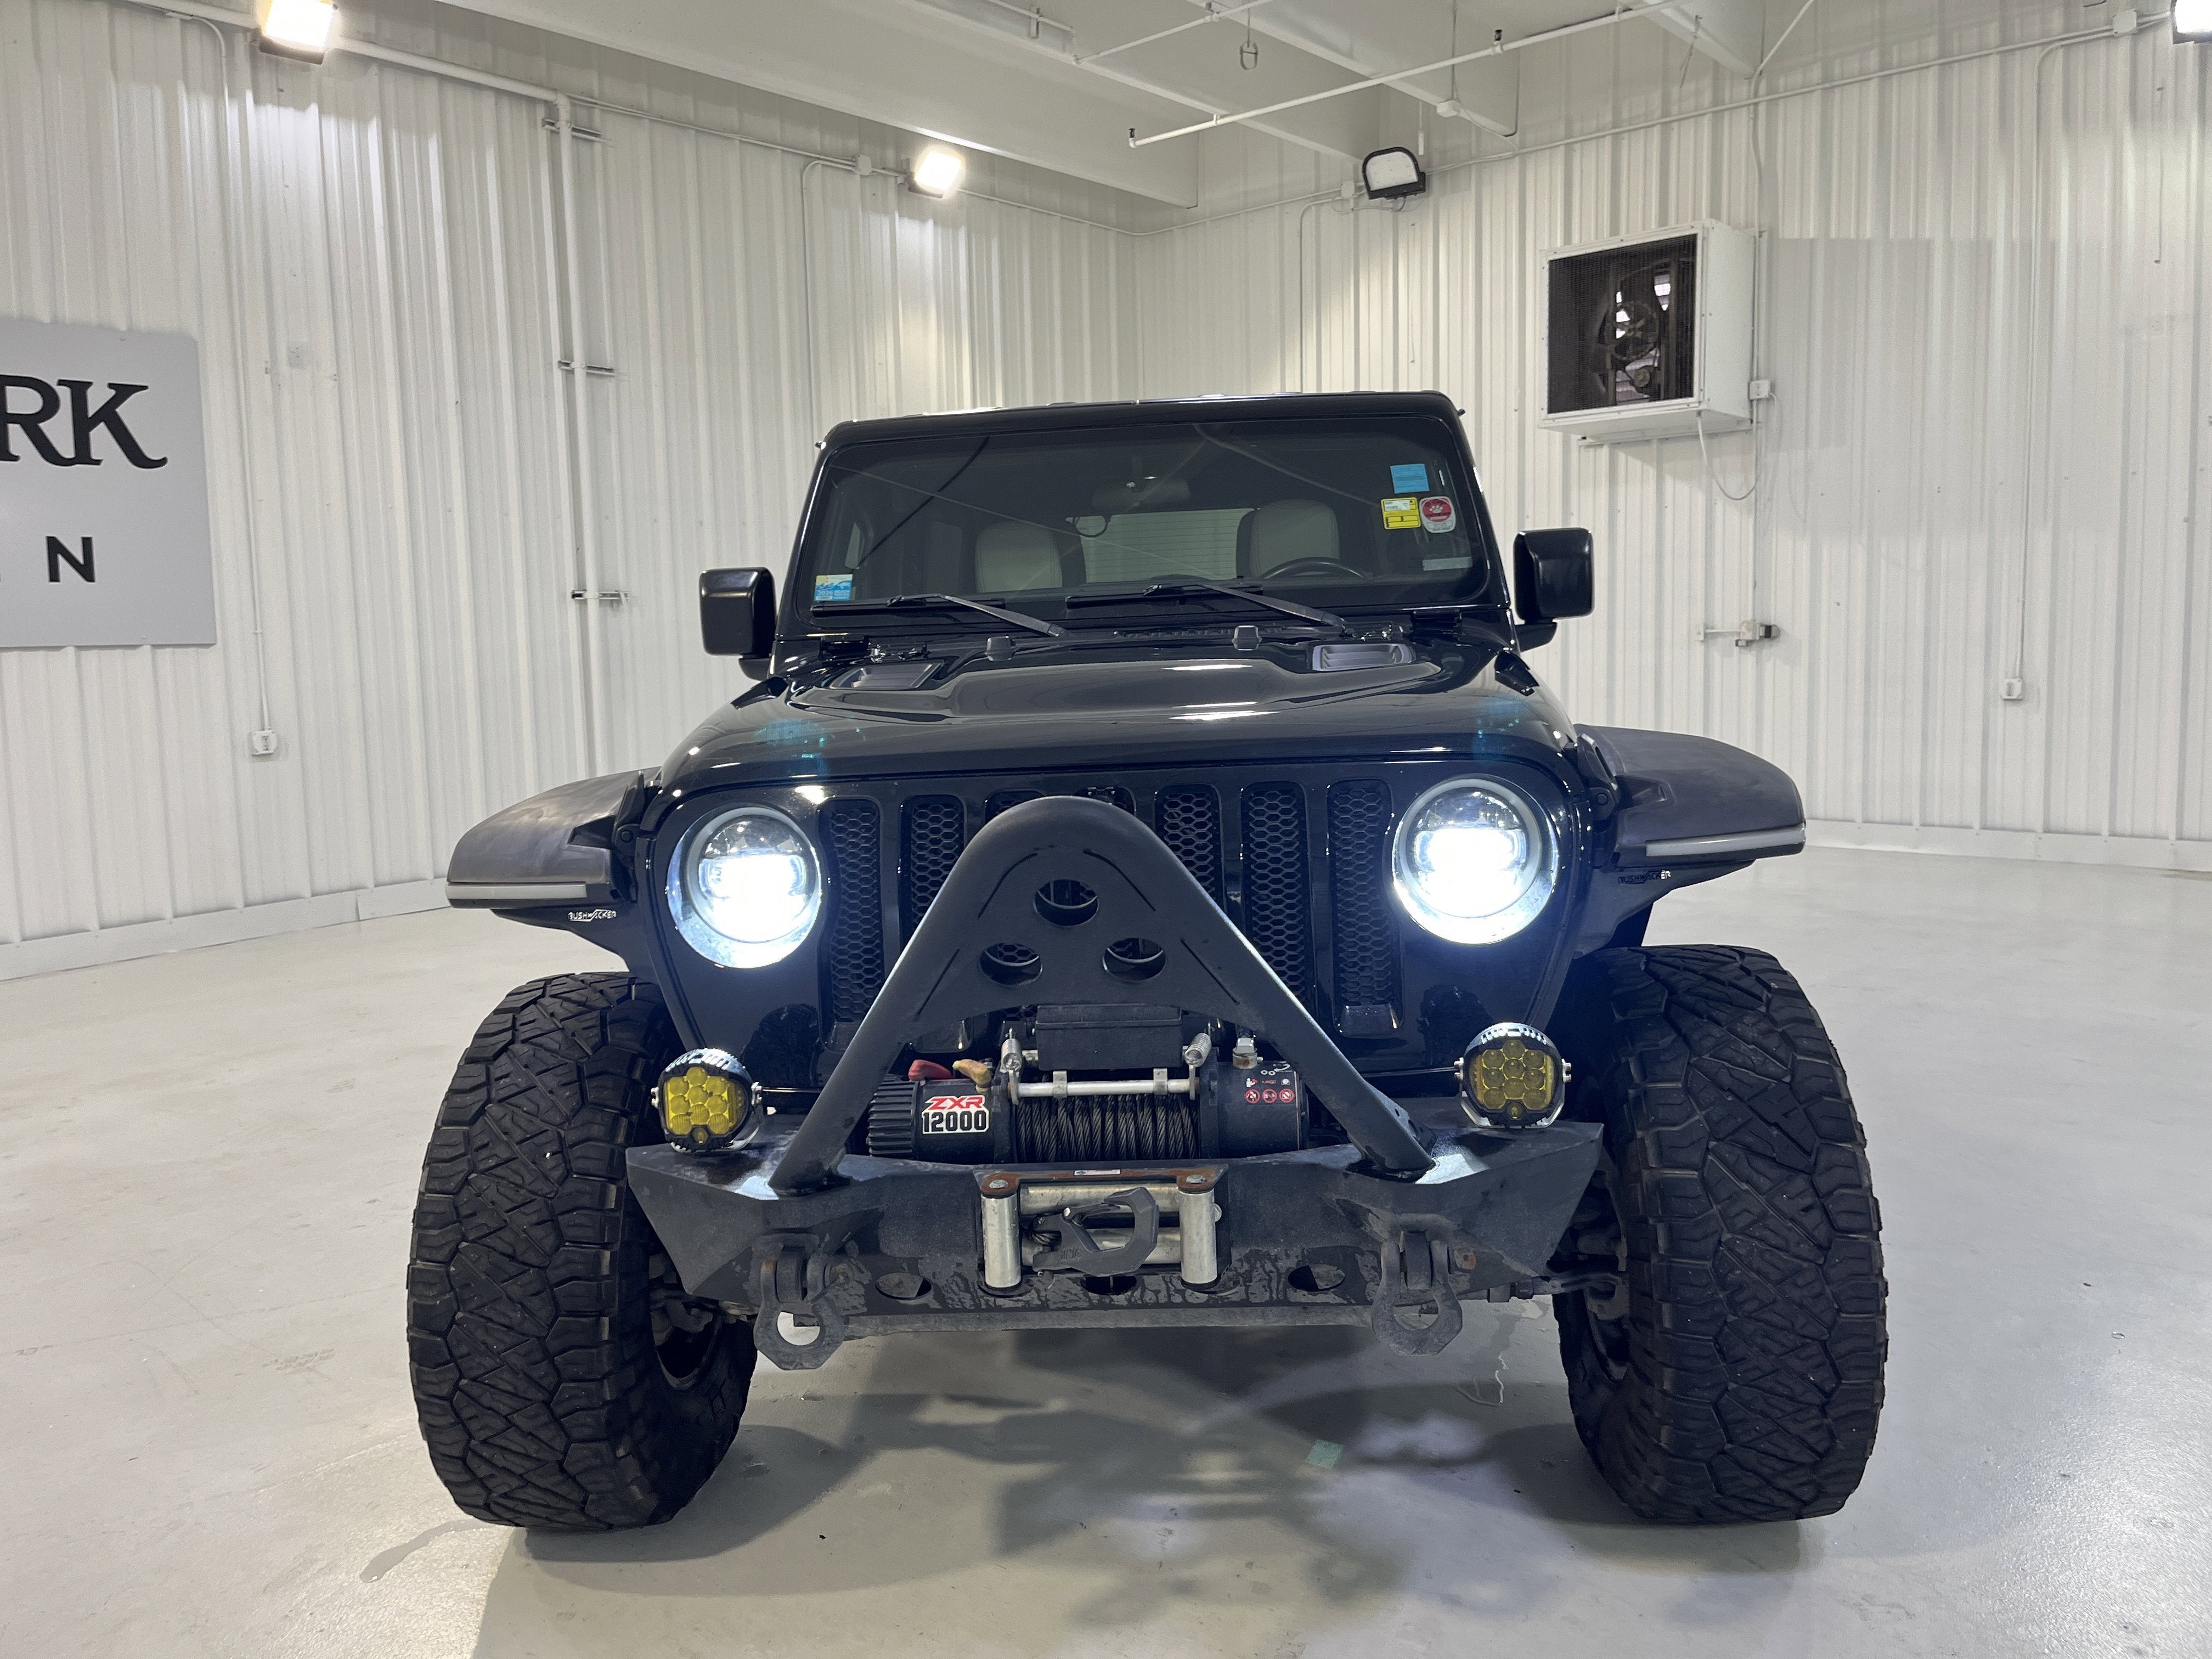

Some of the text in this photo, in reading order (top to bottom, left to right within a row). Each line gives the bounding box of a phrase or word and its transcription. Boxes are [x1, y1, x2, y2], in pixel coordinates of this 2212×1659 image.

[0, 374, 168, 469] RK
[568, 909, 617, 922] BUSHWACKER
[928, 1097, 983, 1110] ZXR
[923, 1110, 987, 1132] 12000
